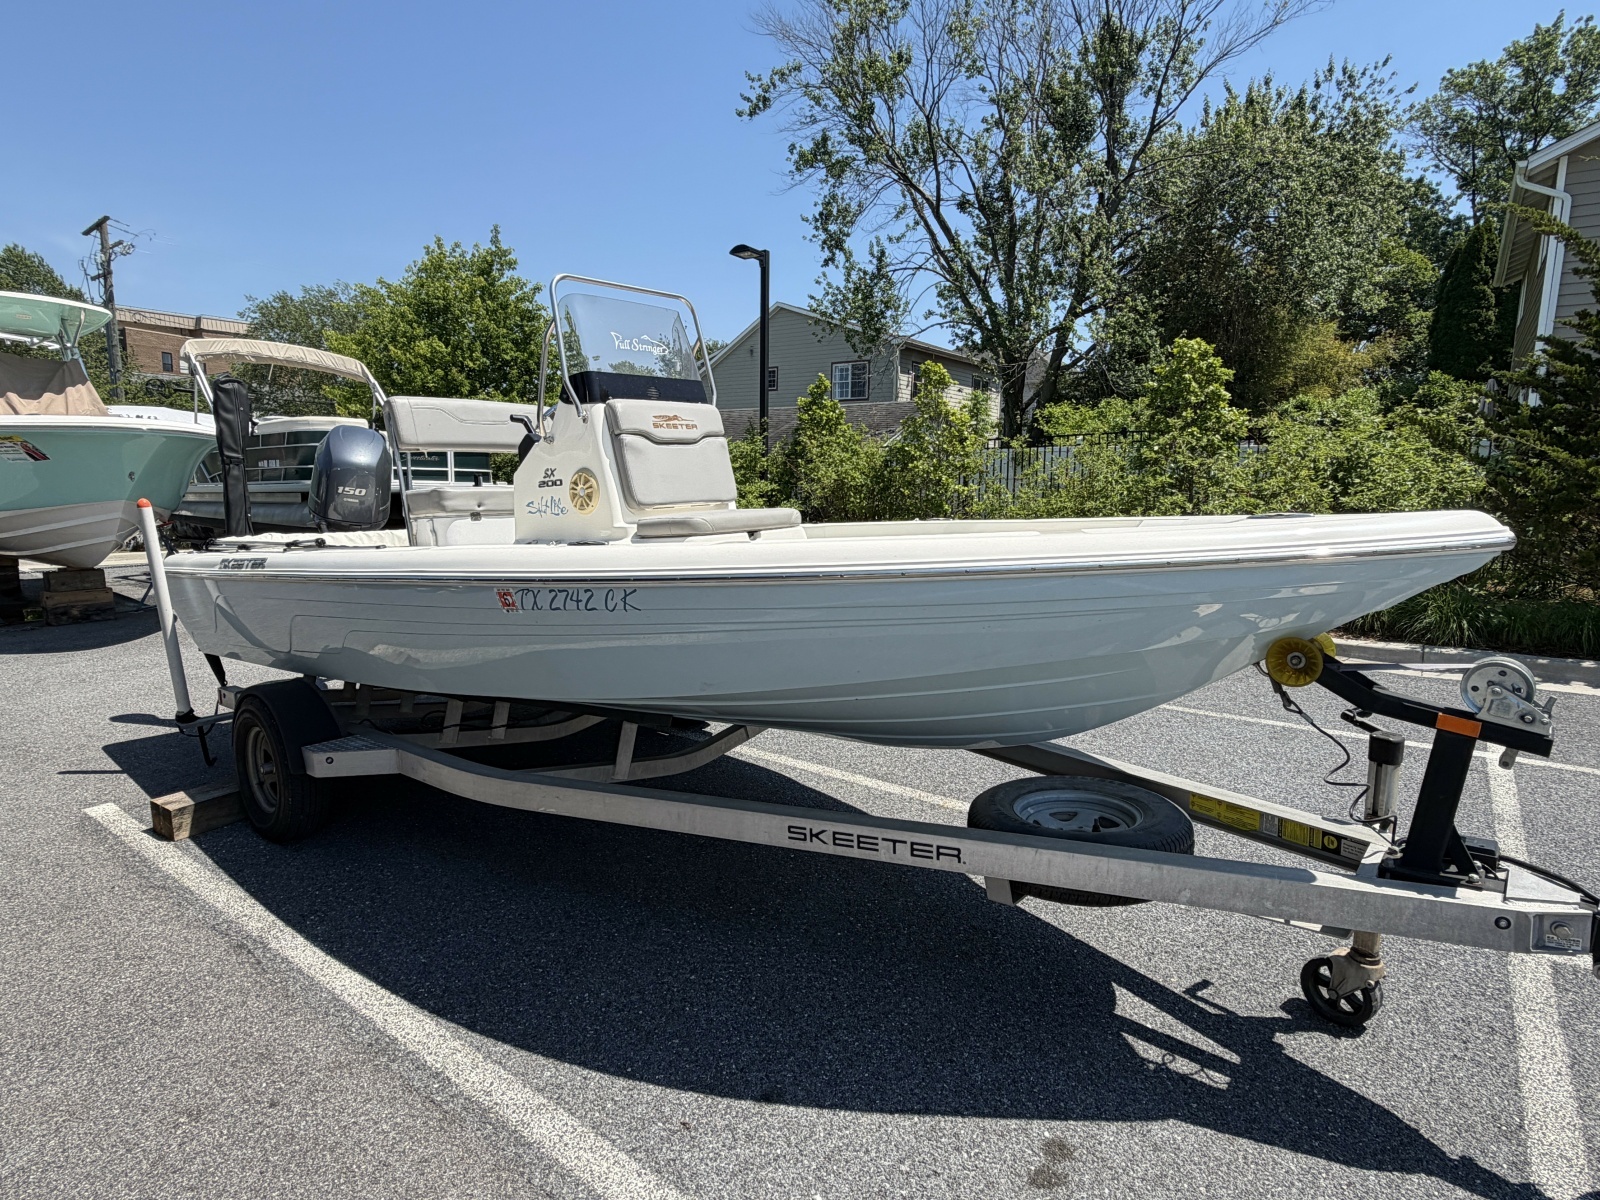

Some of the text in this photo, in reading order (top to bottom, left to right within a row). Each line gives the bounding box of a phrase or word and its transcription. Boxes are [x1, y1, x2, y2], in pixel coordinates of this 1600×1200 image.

[652, 422, 698, 430] SKEETER
[543, 467, 557, 479] SX
[538, 479, 563, 488] 200
[337, 486, 367, 496] 150
[515, 588, 543, 611] TX
[548, 588, 598, 611] 2742
